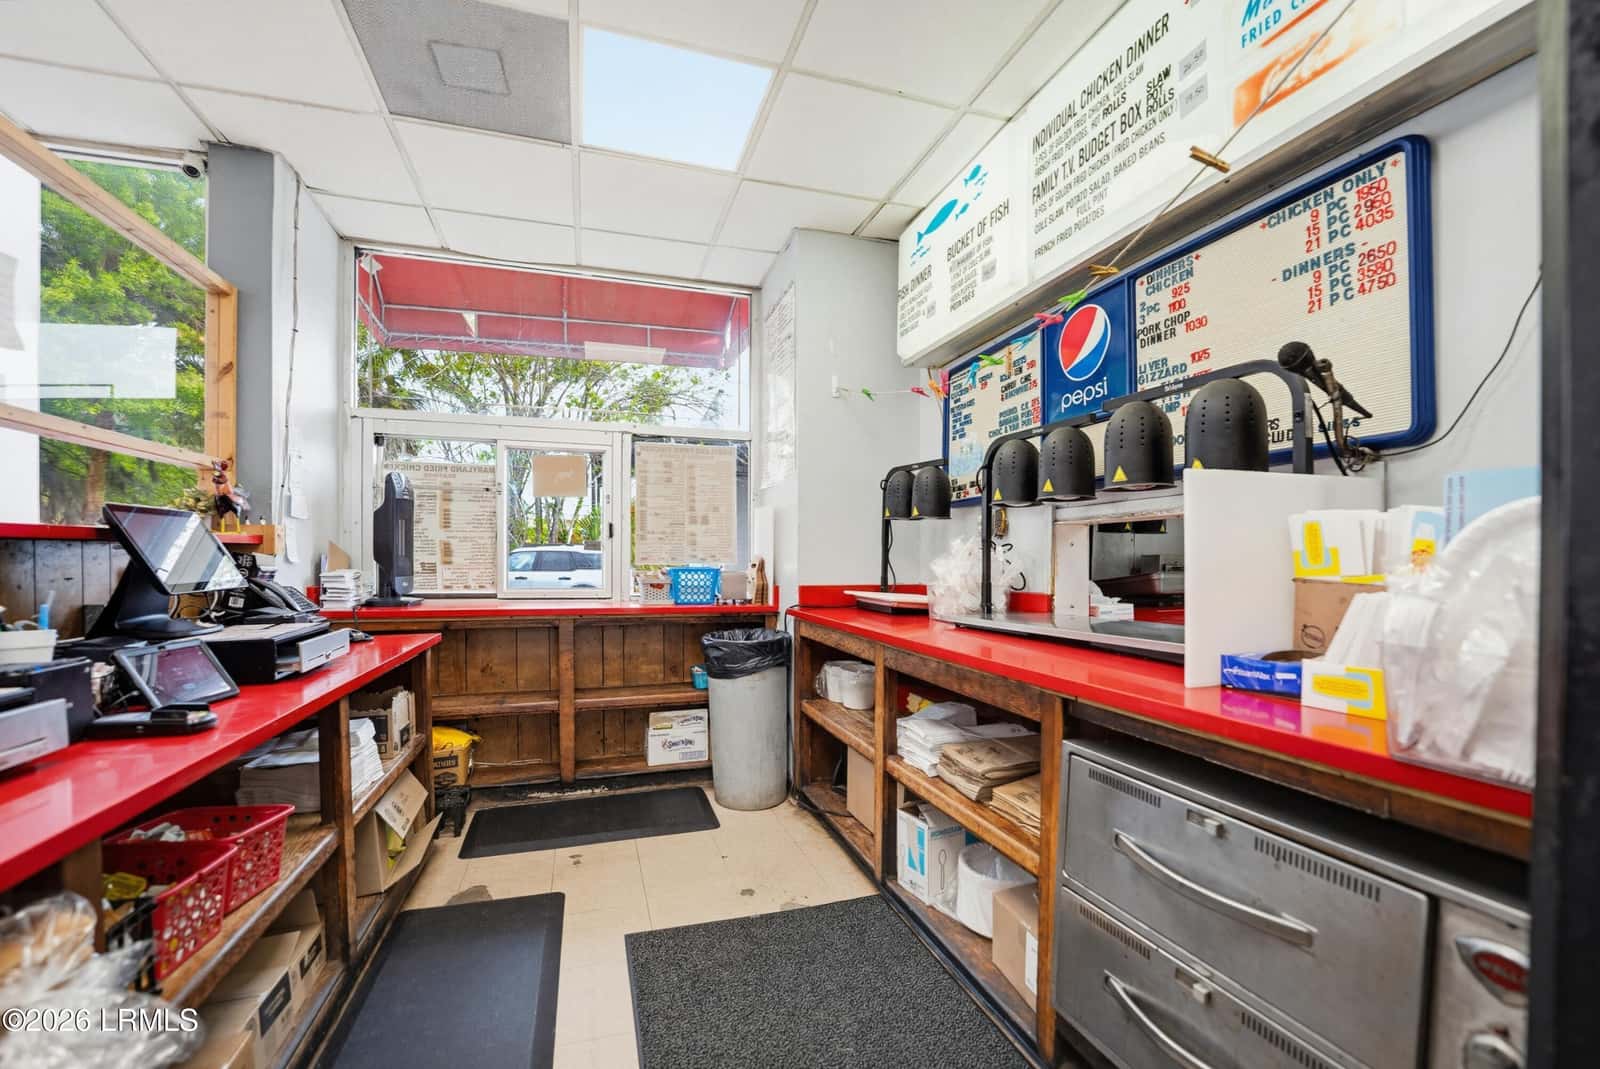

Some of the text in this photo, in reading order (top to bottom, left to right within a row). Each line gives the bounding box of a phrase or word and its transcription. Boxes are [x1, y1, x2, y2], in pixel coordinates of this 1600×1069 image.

[1241, 9, 1282, 48] FRIED
[1032, 98, 1077, 155] INDIVIDUAL
[1080, 55, 1122, 109] CHICKEN
[1126, 12, 1169, 68] DINNER
[1146, 64, 1171, 93] SLAW
[1146, 83, 1164, 106] POT
[1103, 91, 1127, 119] ROLLS
[1146, 87, 1175, 117] ROLLS
[1032, 99, 1142, 205] FAMILY T.V. BUDGET BOX
[1088, 153, 1110, 177] CHICKEN
[1131, 117, 1157, 144] CHICKEN
[1113, 152, 1137, 177] BAKED
[1139, 131, 1166, 159] BEANS
[1267, 161, 1387, 228] CHICKEN ONLY
[1310, 177, 1388, 223] 9 PC 1950
[947, 227, 975, 262] BUCKET
[977, 216, 987, 238] OF
[990, 198, 1009, 228] FISH
[1034, 204, 1104, 260] FRENCH FRIED POTATOES
[1306, 222, 1320, 239] 15
[1327, 210, 1350, 230] PC
[1306, 204, 1394, 253] 21 PC 4035
[1146, 255, 1194, 285] DINNERS
[1282, 243, 1356, 282] DINNERS
[1312, 241, 1397, 284] 9 PC 2650
[1145, 267, 1194, 296] CHICKEN
[1171, 282, 1191, 298] 925
[1307, 272, 1396, 314] 21 PC 4750
[1308, 283, 1322, 299] 15
[1330, 273, 1352, 292] PC
[1136, 311, 1190, 339] PORK CHOP
[1138, 315, 1146, 325] 3
[1140, 315, 1208, 348] DINNER 1030
[1138, 357, 1168, 374] LIVER
[1138, 362, 1187, 385] GIZZARD
[1061, 376, 1108, 413] pepsi
